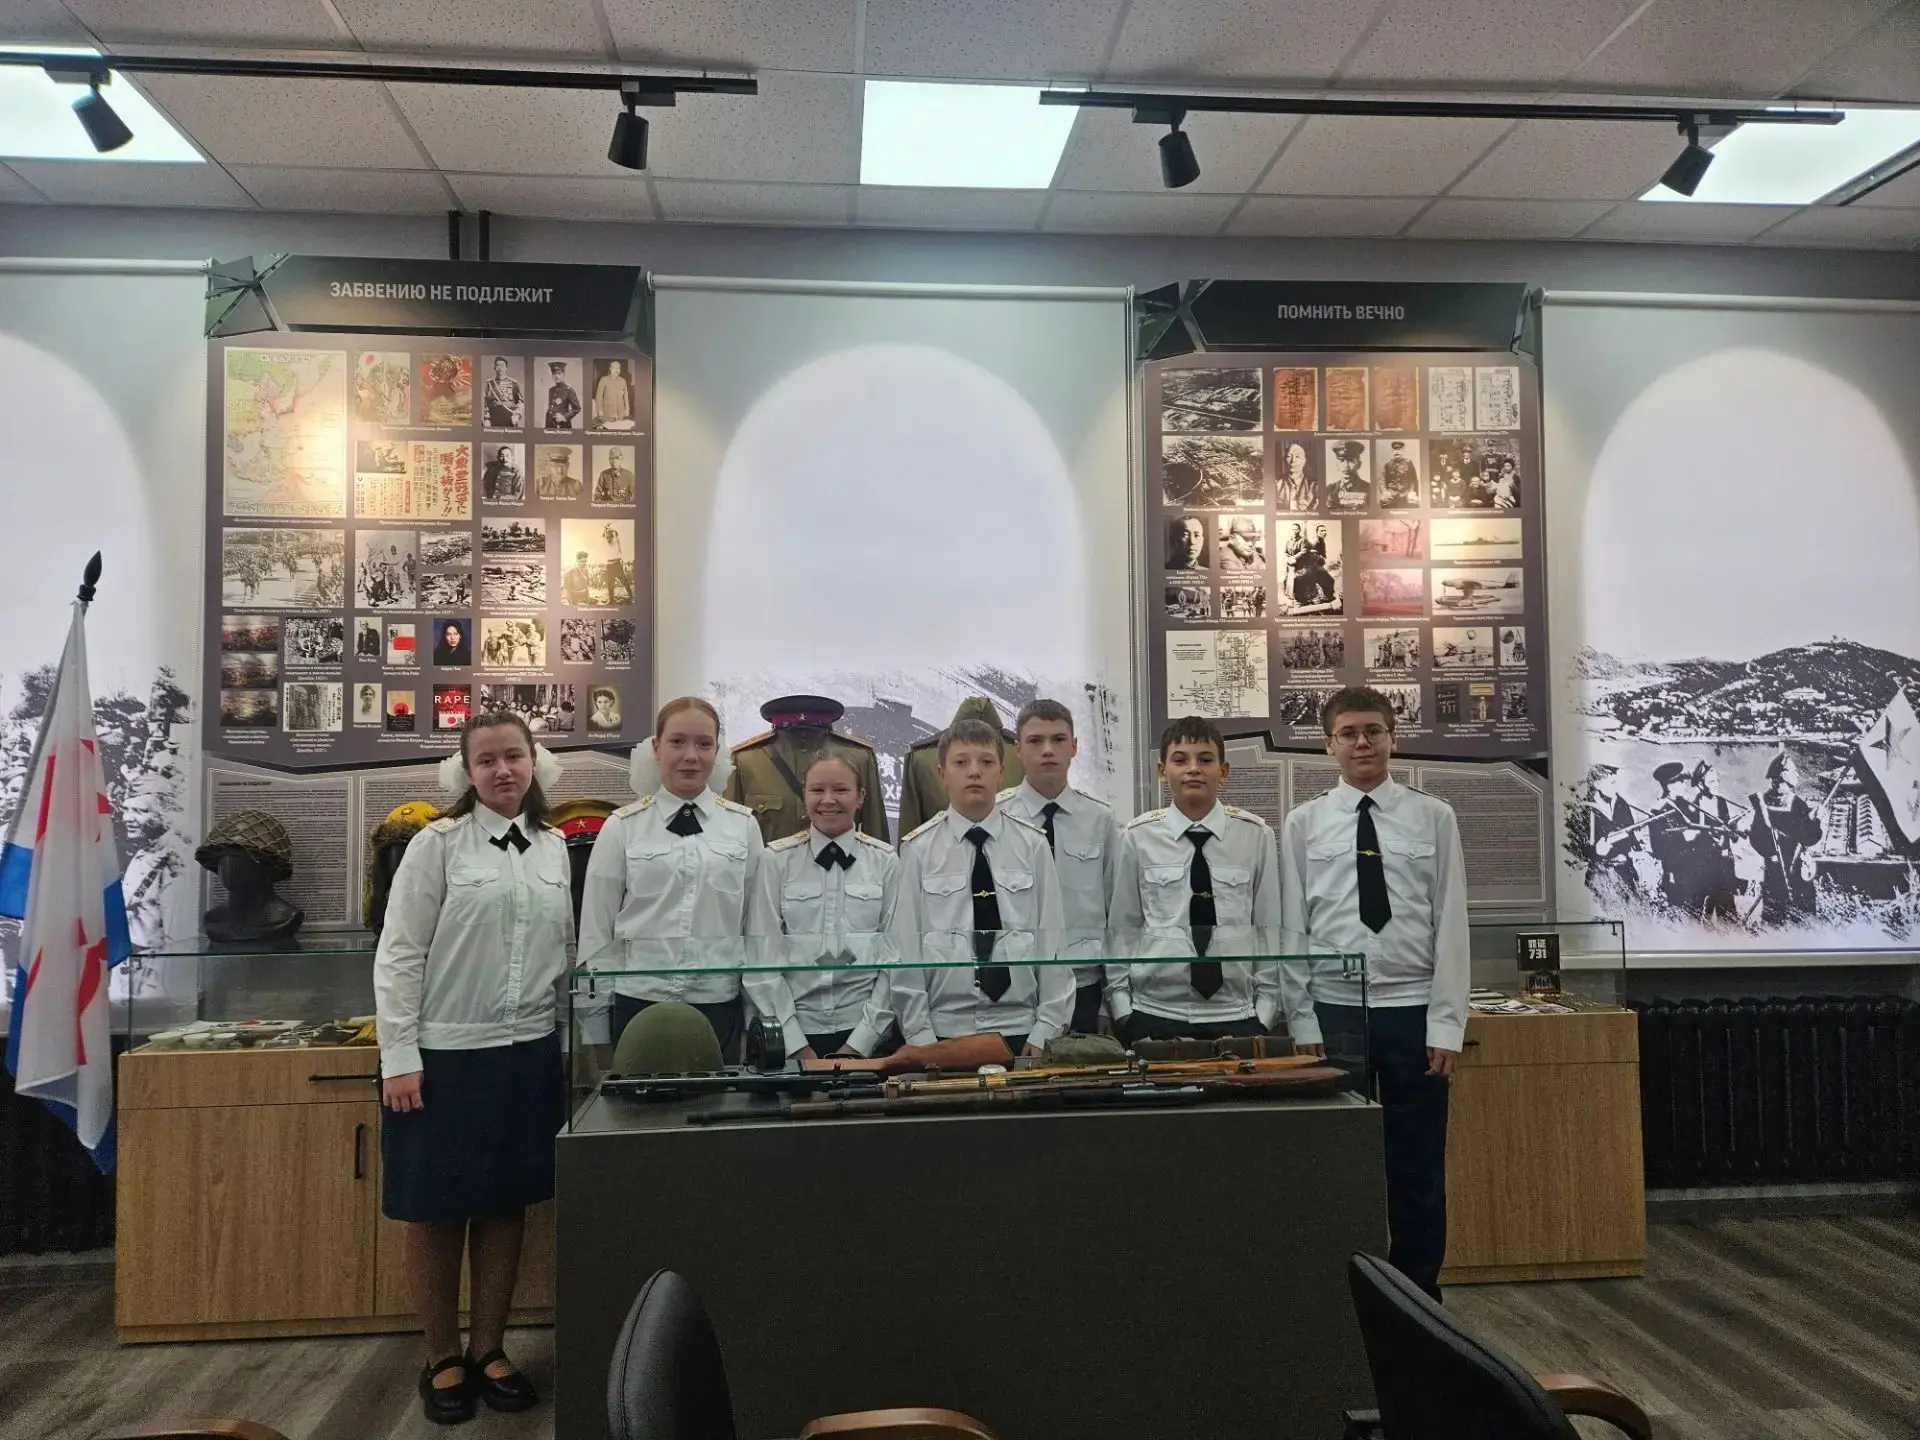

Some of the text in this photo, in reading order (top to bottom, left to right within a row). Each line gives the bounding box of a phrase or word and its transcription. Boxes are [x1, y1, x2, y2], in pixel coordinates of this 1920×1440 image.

[329, 281, 553, 304] ЗАБВЕНИЮ НЕ ПОДЛЕЖИТ
[1278, 304, 1405, 320] ПОМНИТЬ ВЕЧНО
[434, 695, 471, 704] RAPE
[1529, 948, 1547, 960] 731
